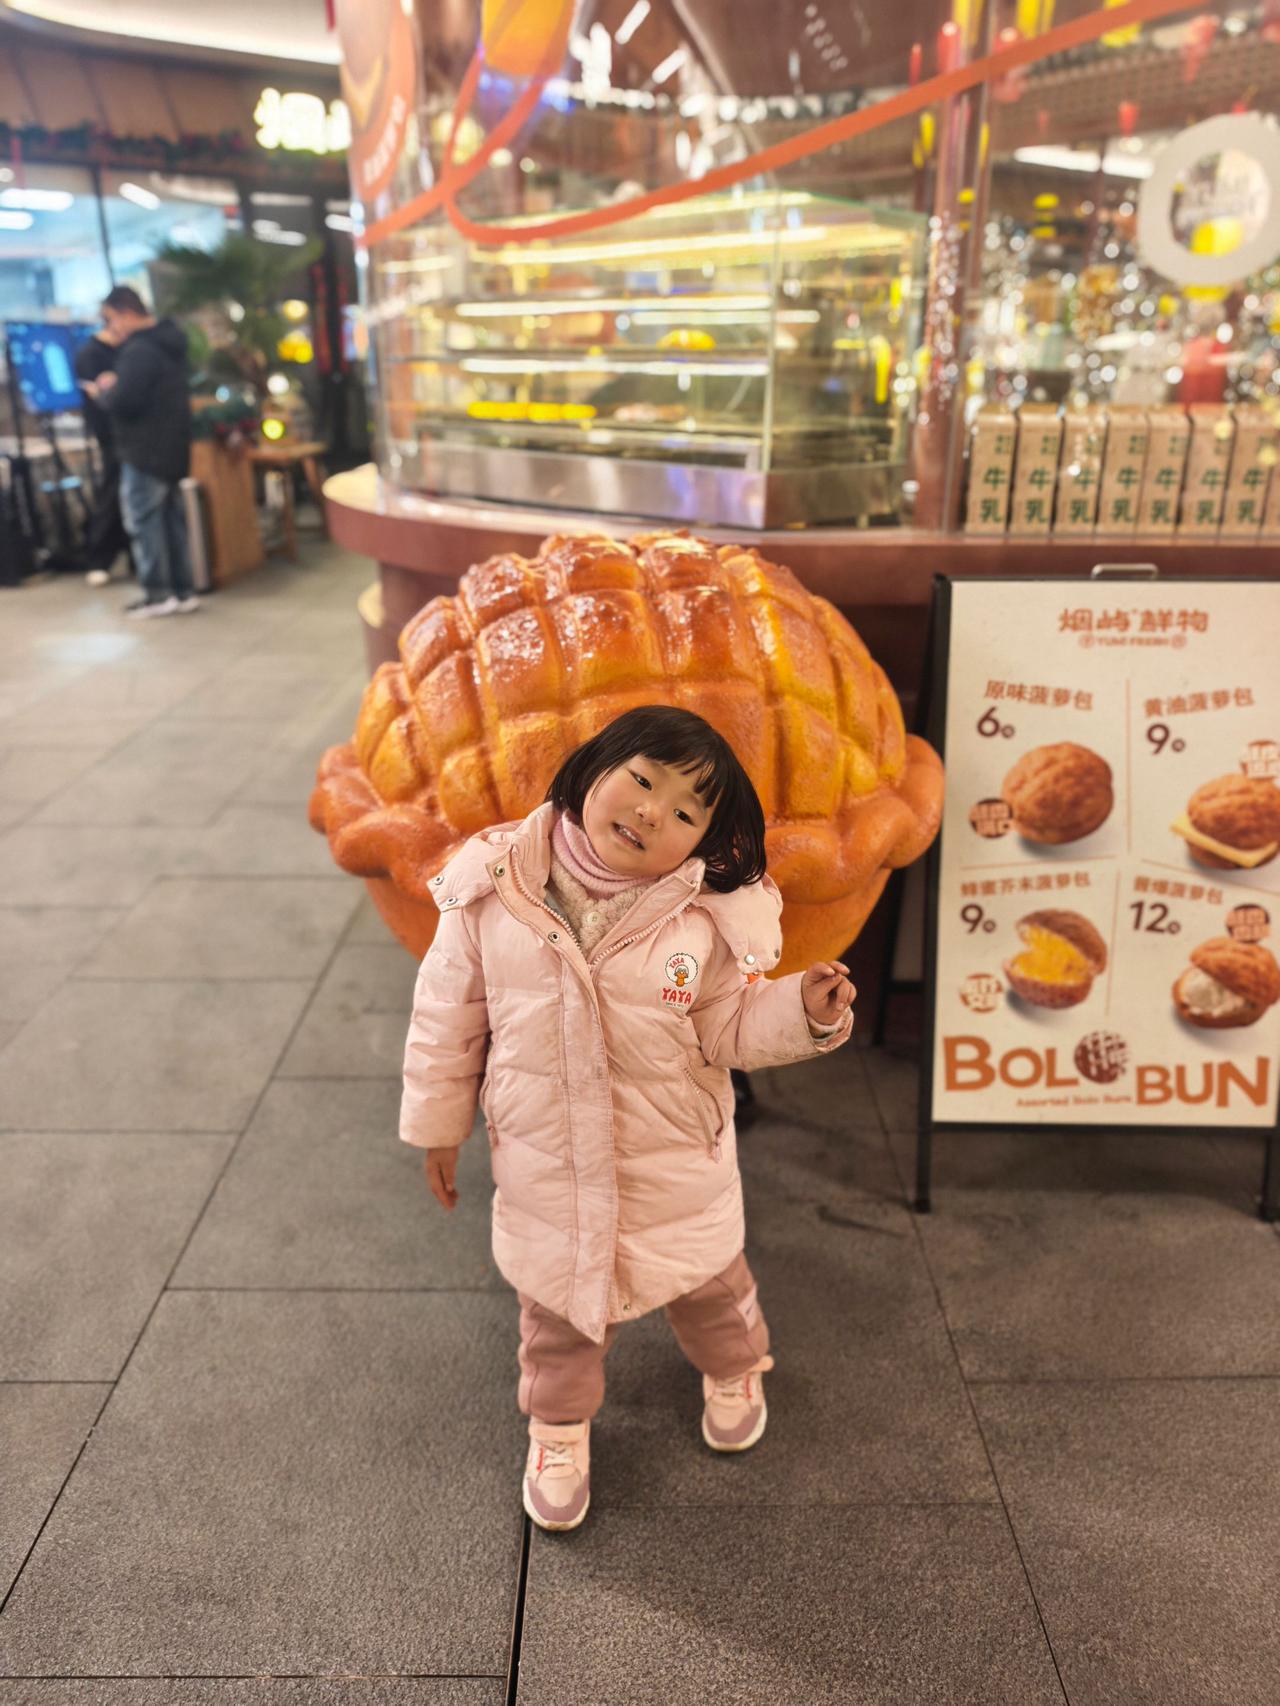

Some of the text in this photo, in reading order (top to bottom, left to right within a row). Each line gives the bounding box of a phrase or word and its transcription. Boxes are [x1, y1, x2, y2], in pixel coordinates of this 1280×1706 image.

[981, 465, 1005, 523] 牛乳
[1026, 466, 1049, 523] 牛乳
[1069, 467, 1095, 524] 牛乳
[1112, 465, 1139, 523] 牛乳
[1151, 466, 1175, 524] 牛乳
[1196, 468, 1221, 524] 牛乳
[1238, 466, 1264, 524] 牛乳
[669, 957, 684, 968] YAYA
[662, 987, 692, 1004] YAYA
[1136, 1056, 1269, 1108] BUN
